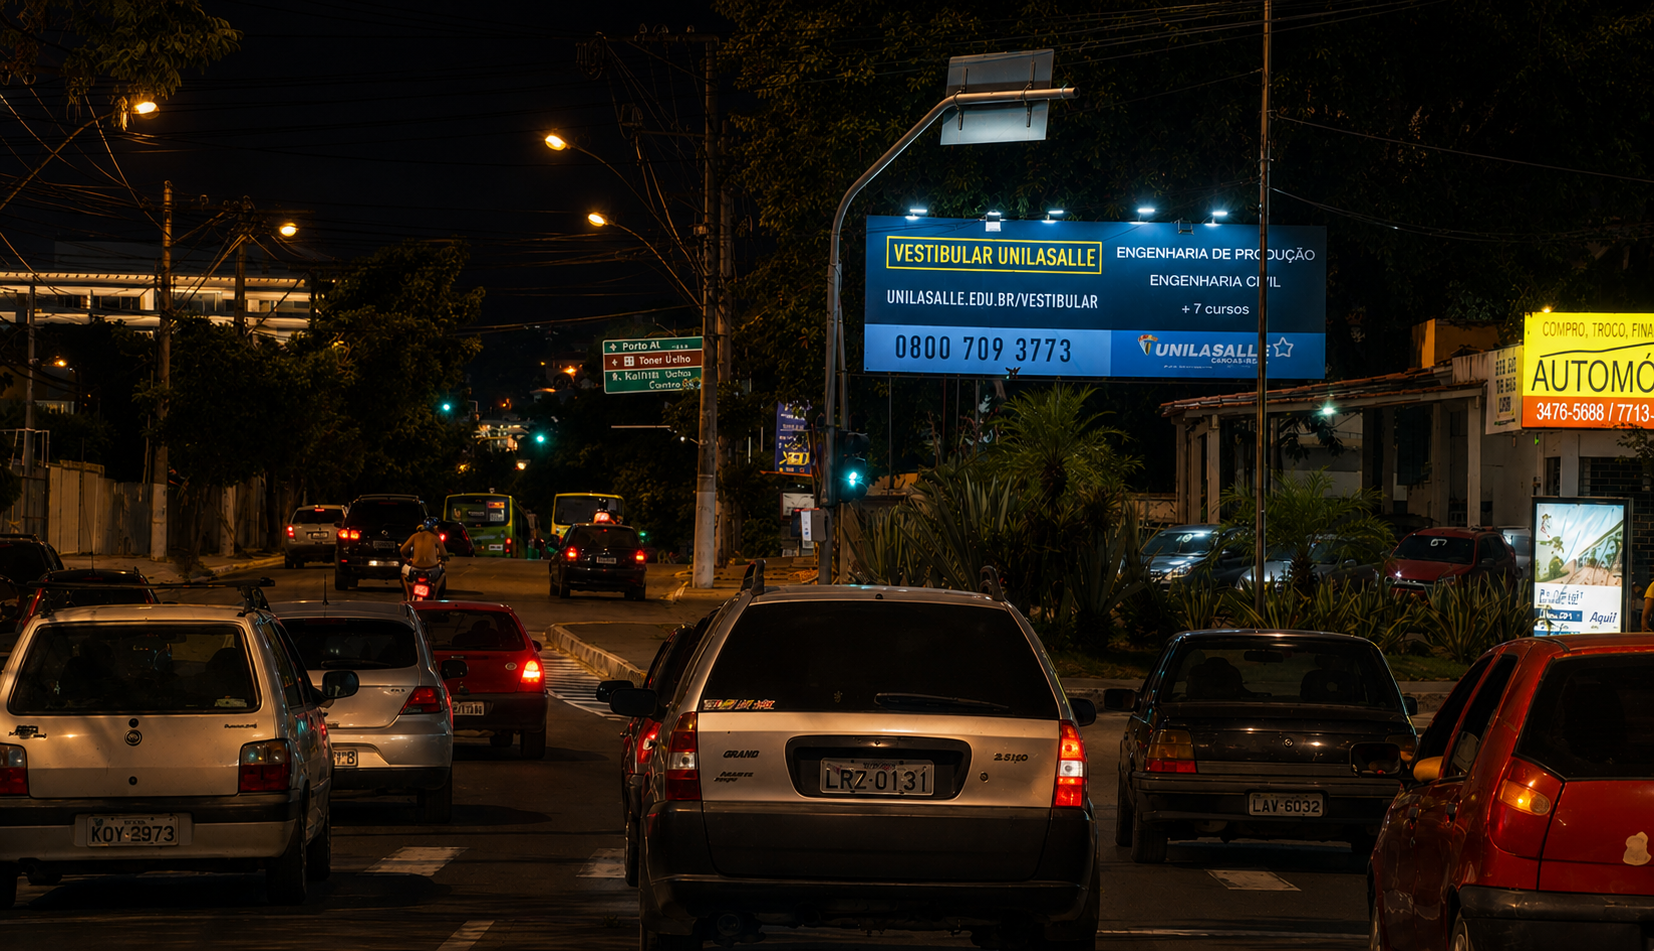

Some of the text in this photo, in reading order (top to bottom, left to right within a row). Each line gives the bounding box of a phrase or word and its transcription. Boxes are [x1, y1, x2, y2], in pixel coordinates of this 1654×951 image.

[894, 243, 1096, 267] VESTIBULAR UNILASALLE
[1116, 246, 1209, 260] ENGENHARIA
[1212, 248, 1231, 260] DE
[1149, 274, 1281, 288] ENGENHARIA CIIL
[886, 289, 1098, 309] UNILASALLE.EDU.BR/VESTIBULAR
[1193, 303, 1201, 314] 7
[1204, 304, 1250, 315] cursos
[1542, 321, 1589, 338] COMPRO,
[1592, 322, 1628, 340] TROCO,
[622, 342, 648, 351] Porto
[895, 334, 1071, 363] 0800 709 3773
[1531, 353, 1654, 393] AUTOMÓ
[1536, 402, 1605, 421] 3476-5688
[723, 750, 760, 758] GRAND
[1252, 799, 1320, 813] LAV-6032
